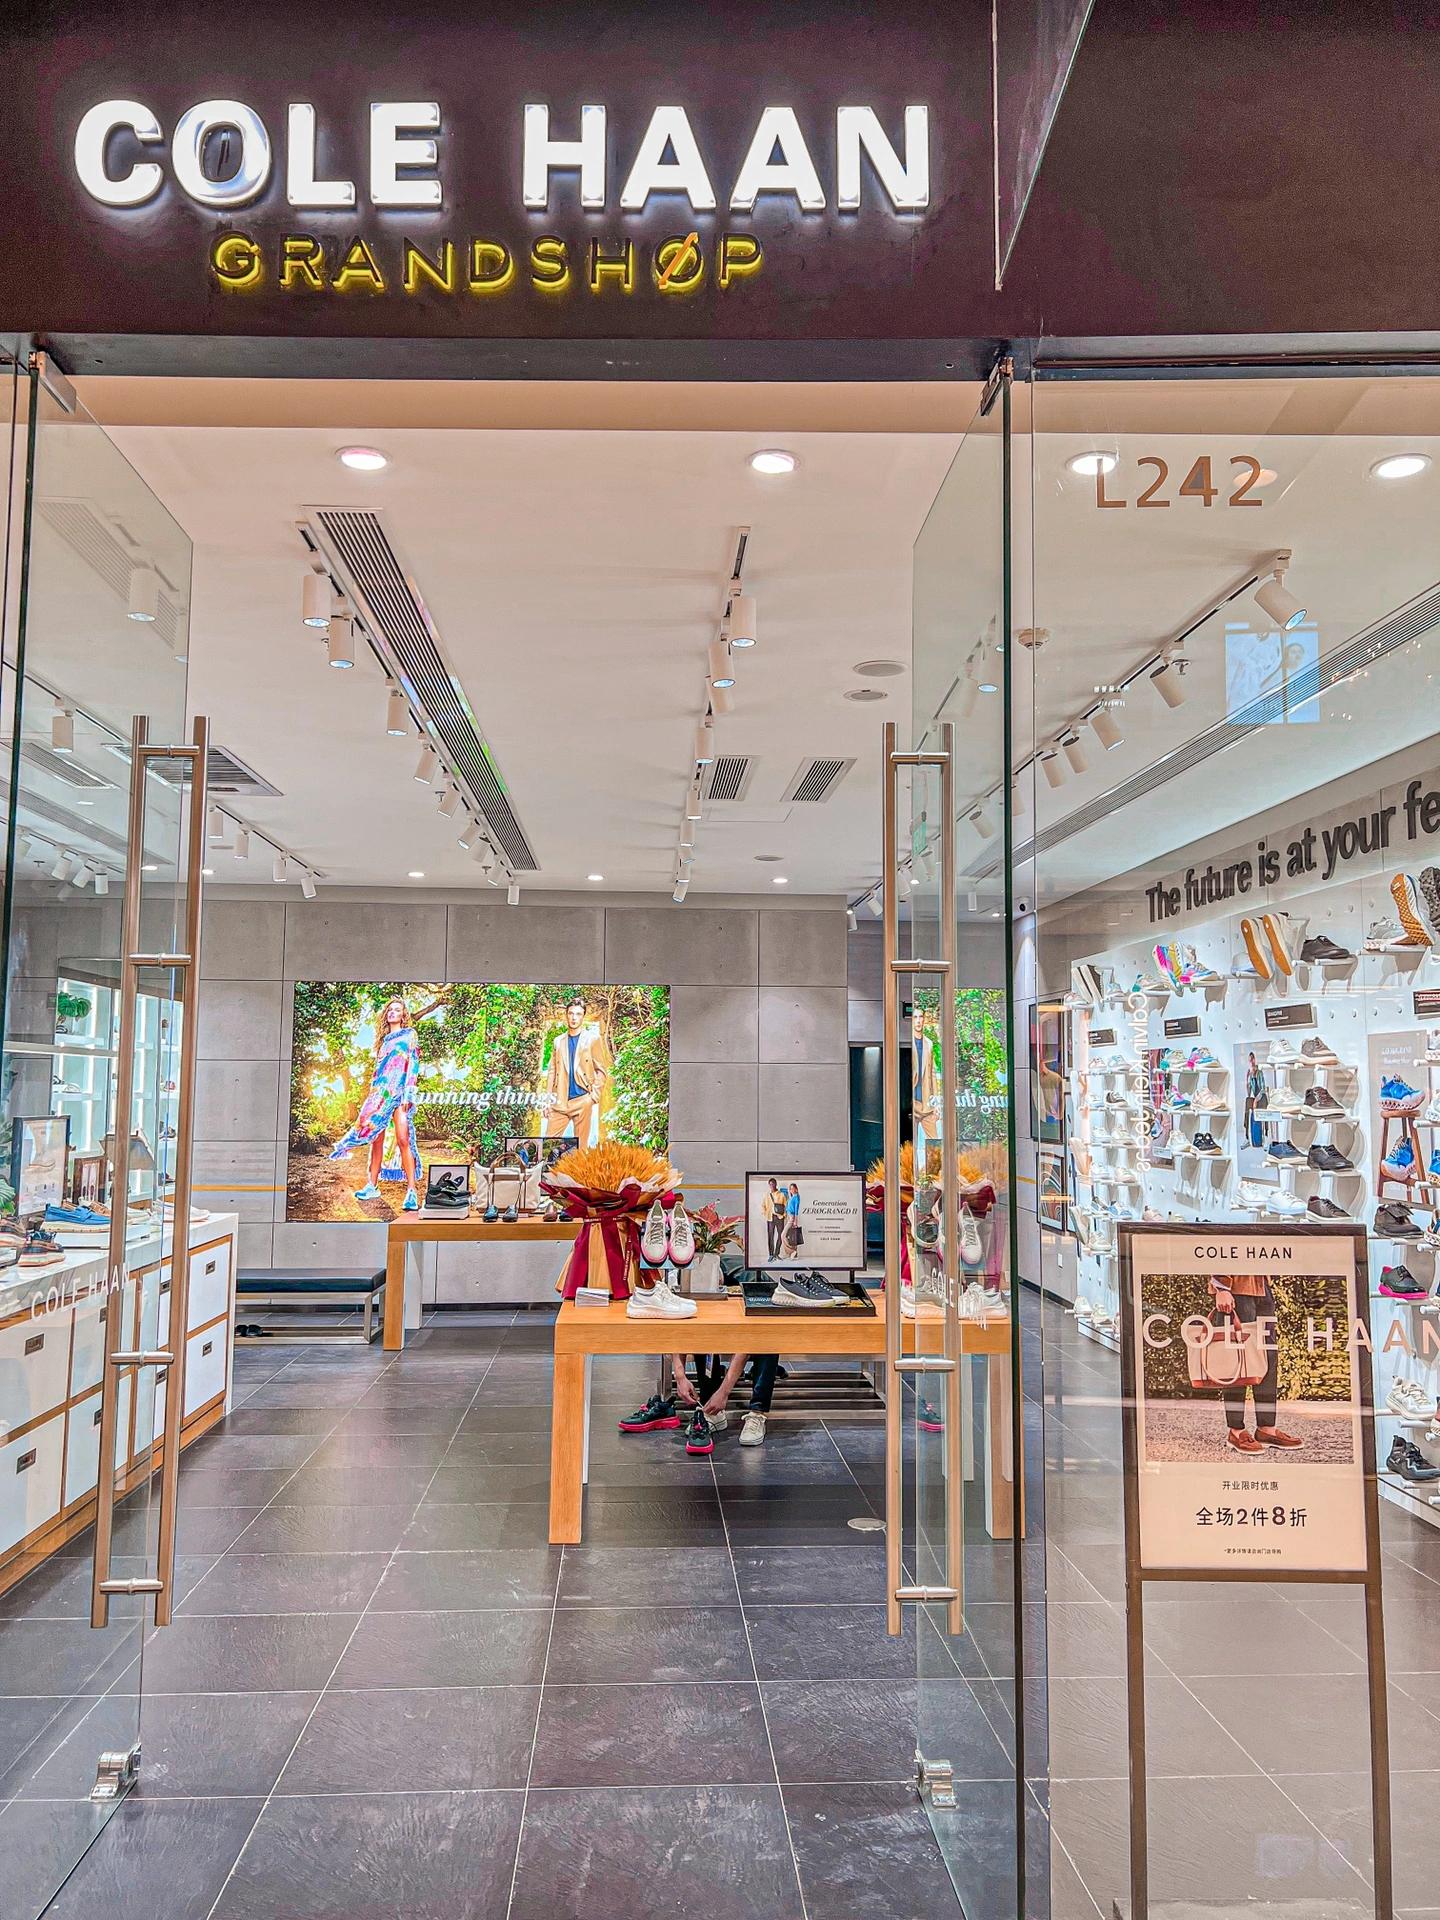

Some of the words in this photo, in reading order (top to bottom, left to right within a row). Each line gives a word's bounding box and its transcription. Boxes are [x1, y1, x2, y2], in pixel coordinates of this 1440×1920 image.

[74, 99, 443, 206] COLE
[523, 103, 930, 212] HAAN
[1096, 455, 1263, 508] L242
[1145, 881, 1181, 922] The
[1184, 860, 1253, 910] future
[1258, 841, 1280, 886] is
[1287, 827, 1317, 878] at
[1322, 806, 1396, 880] your
[1194, 1246, 1239, 1259] COLE
[1246, 1247, 1292, 1259] HAAN
[31, 1277, 81, 1322] COLE
[88, 1261, 130, 1300] HAAN
[1143, 1314, 1278, 1350] COLE
[1222, 1481, 1279, 1491] 开业限时优惠
[1196, 1506, 1307, 1527] 全场2件8折
